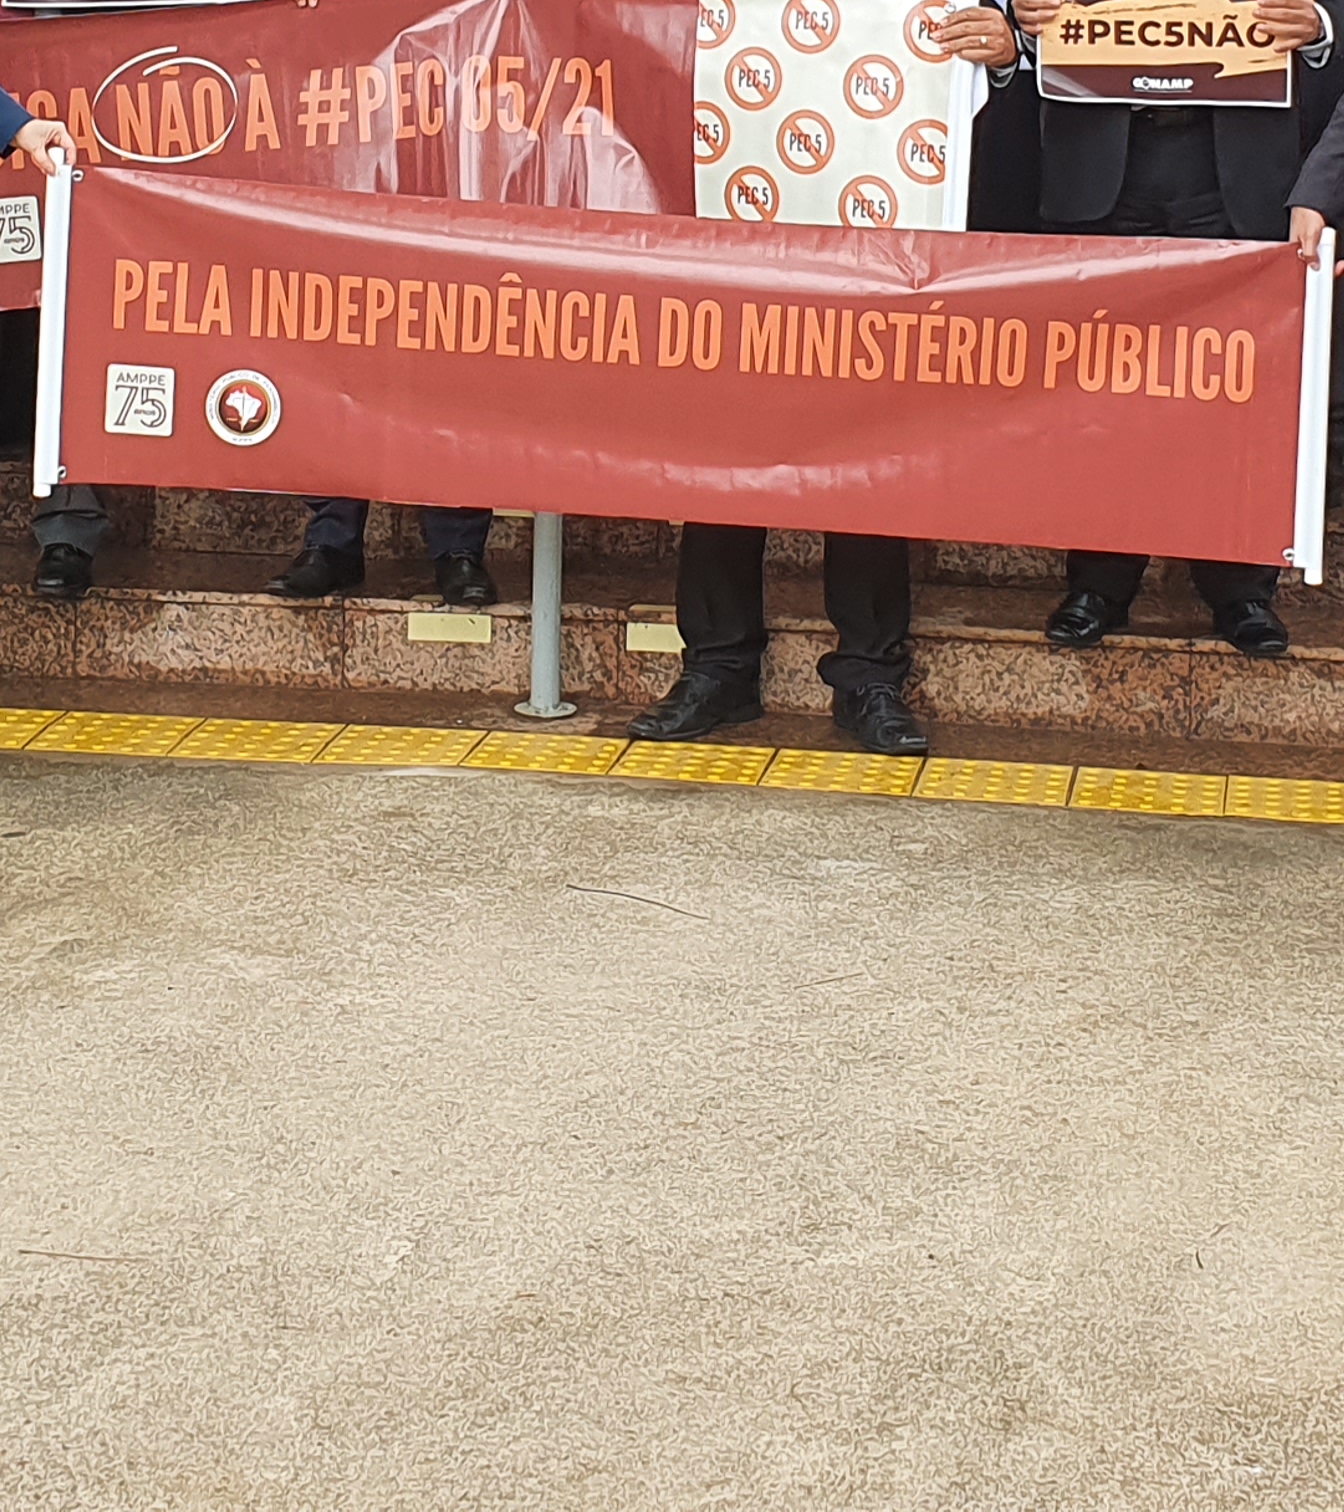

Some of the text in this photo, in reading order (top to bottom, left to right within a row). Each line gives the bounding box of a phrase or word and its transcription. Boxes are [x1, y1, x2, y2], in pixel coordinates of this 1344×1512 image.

[796, 11, 828, 30] PEC 5
[1060, 15, 1275, 48] #PEC5NÃO
[738, 68, 770, 88] PEC 5
[855, 76, 889, 96] PEC 5
[115, 66, 226, 162] NÃO
[244, 60, 281, 153] À
[297, 56, 445, 147] #PEC
[461, 54, 614, 142] 05/21
[789, 133, 821, 153] PEC 5
[911, 143, 946, 163] PEC 5
[737, 186, 768, 205] PEC 5
[852, 199, 886, 218] PEC 5
[113, 259, 1255, 403] PELA INDEPENDÊNCIA DO MINISTÉRIO PÚBLICO
[116, 373, 166, 385] AMPPE
[115, 385, 167, 427] 75
